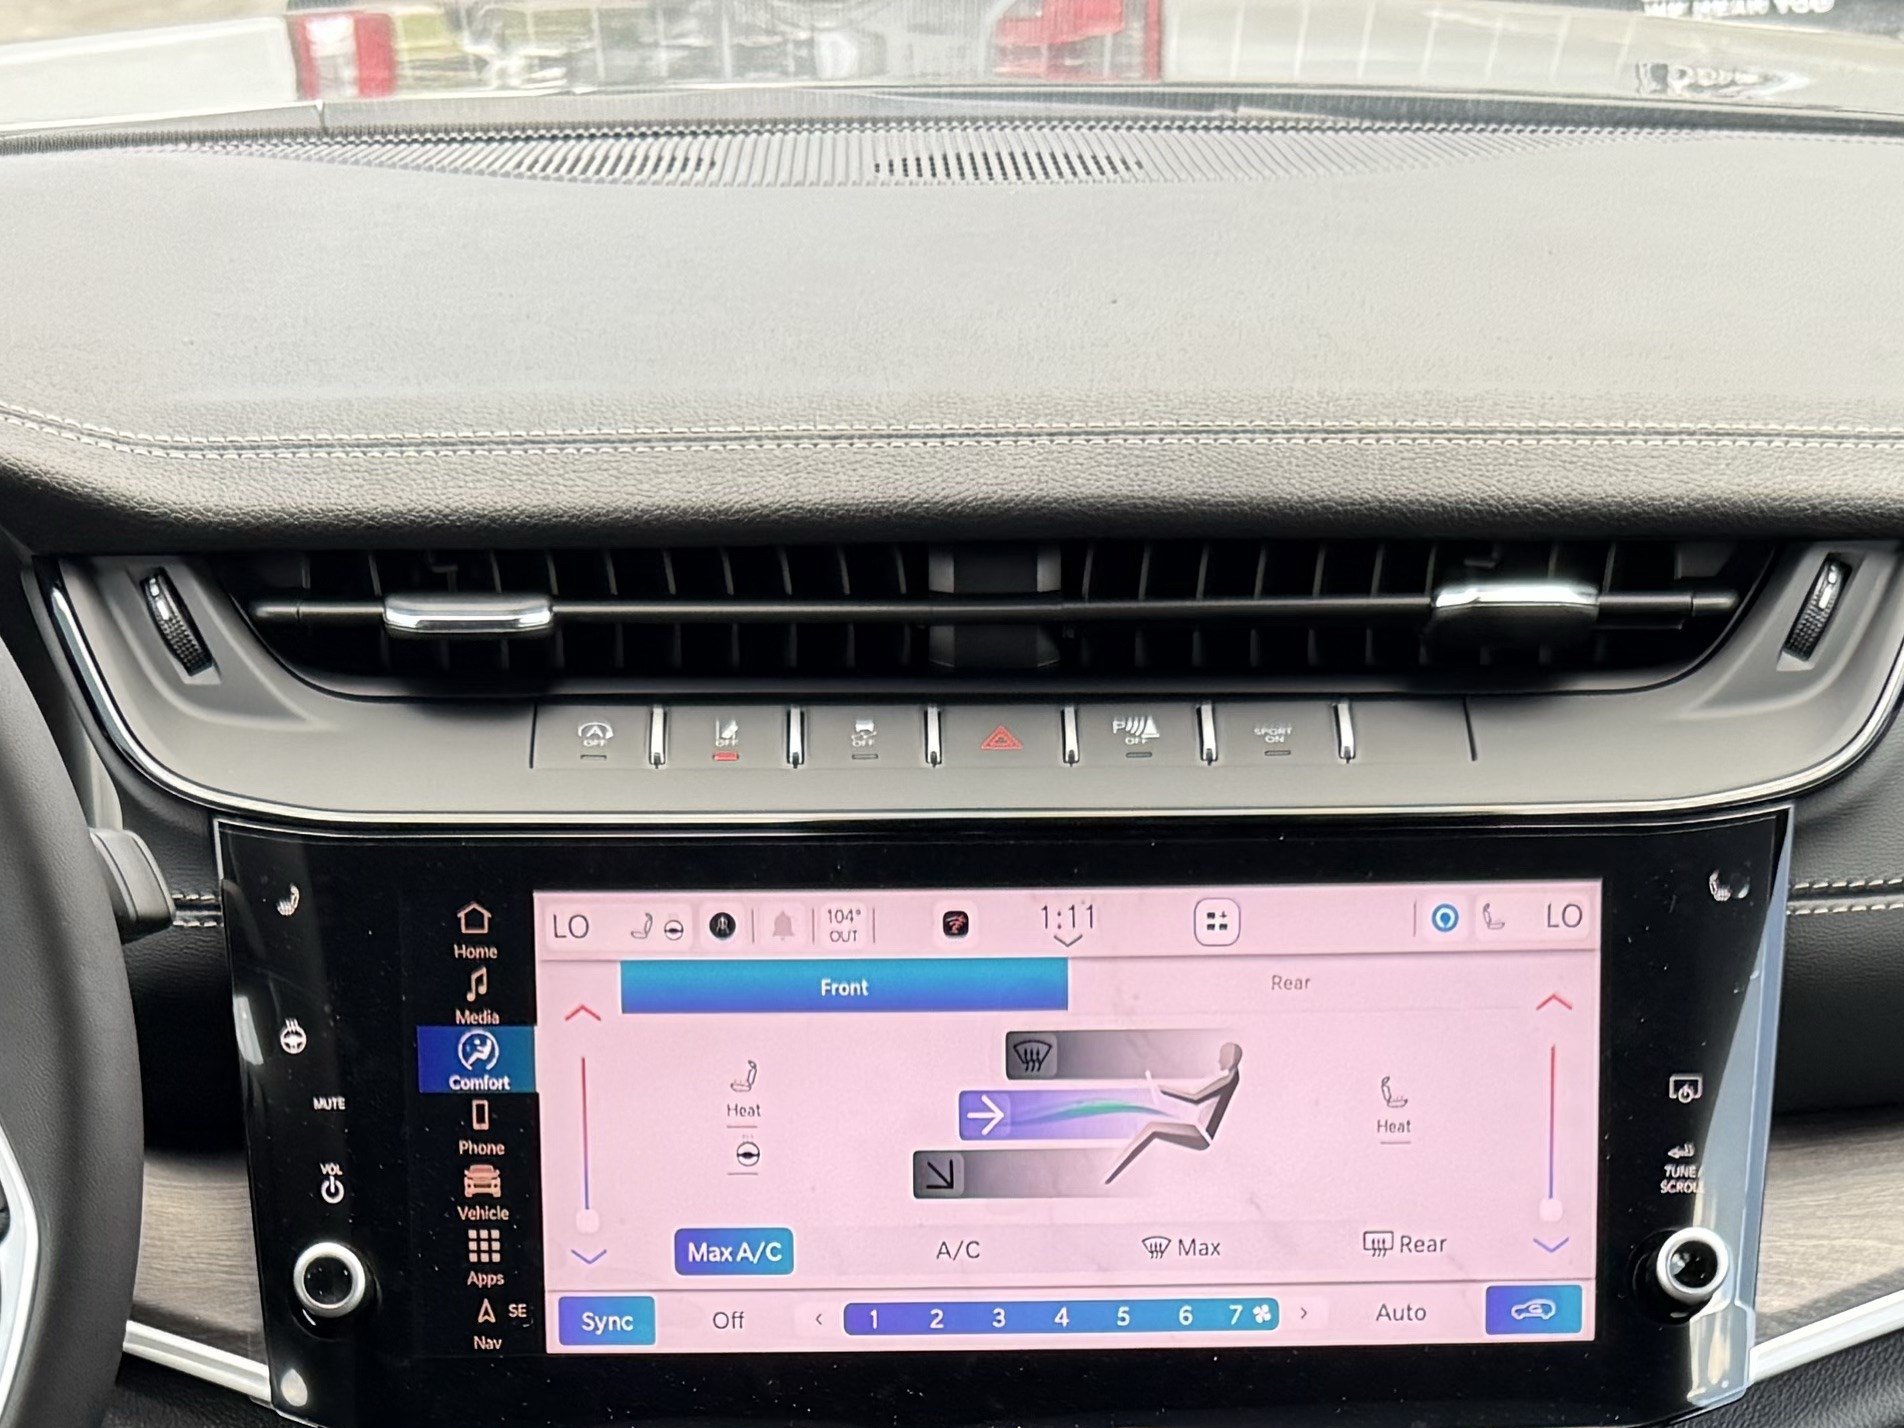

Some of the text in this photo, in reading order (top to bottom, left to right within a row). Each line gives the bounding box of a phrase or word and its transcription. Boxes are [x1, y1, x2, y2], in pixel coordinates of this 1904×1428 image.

[1041, 904, 1096, 930] 1:11
[1547, 904, 1582, 928] LO
[552, 914, 589, 938] LO
[829, 929, 858, 943] OUT
[454, 944, 498, 959] Home
[821, 978, 869, 997] Front
[1271, 974, 1311, 990] Rear
[455, 1009, 500, 1025] Media
[449, 1074, 510, 1091] Comfort
[313, 1097, 345, 1110] MUTE
[726, 1103, 761, 1118] Heat
[1377, 1118, 1412, 1134] Heat
[459, 1140, 505, 1156] Phone
[320, 1162, 343, 1175] VOL
[457, 1206, 509, 1221] Vehicle
[688, 1241, 782, 1264] Max A/C
[936, 1240, 981, 1261] A/C
[1178, 1237, 1221, 1258] Max
[1400, 1234, 1447, 1255] Rear
[467, 1271, 505, 1287] Apps
[509, 1304, 527, 1318] SE
[1375, 1303, 1428, 1323] Auto
[581, 1312, 634, 1335] Sync
[712, 1311, 745, 1331] Off
[473, 1336, 502, 1350] Nav
